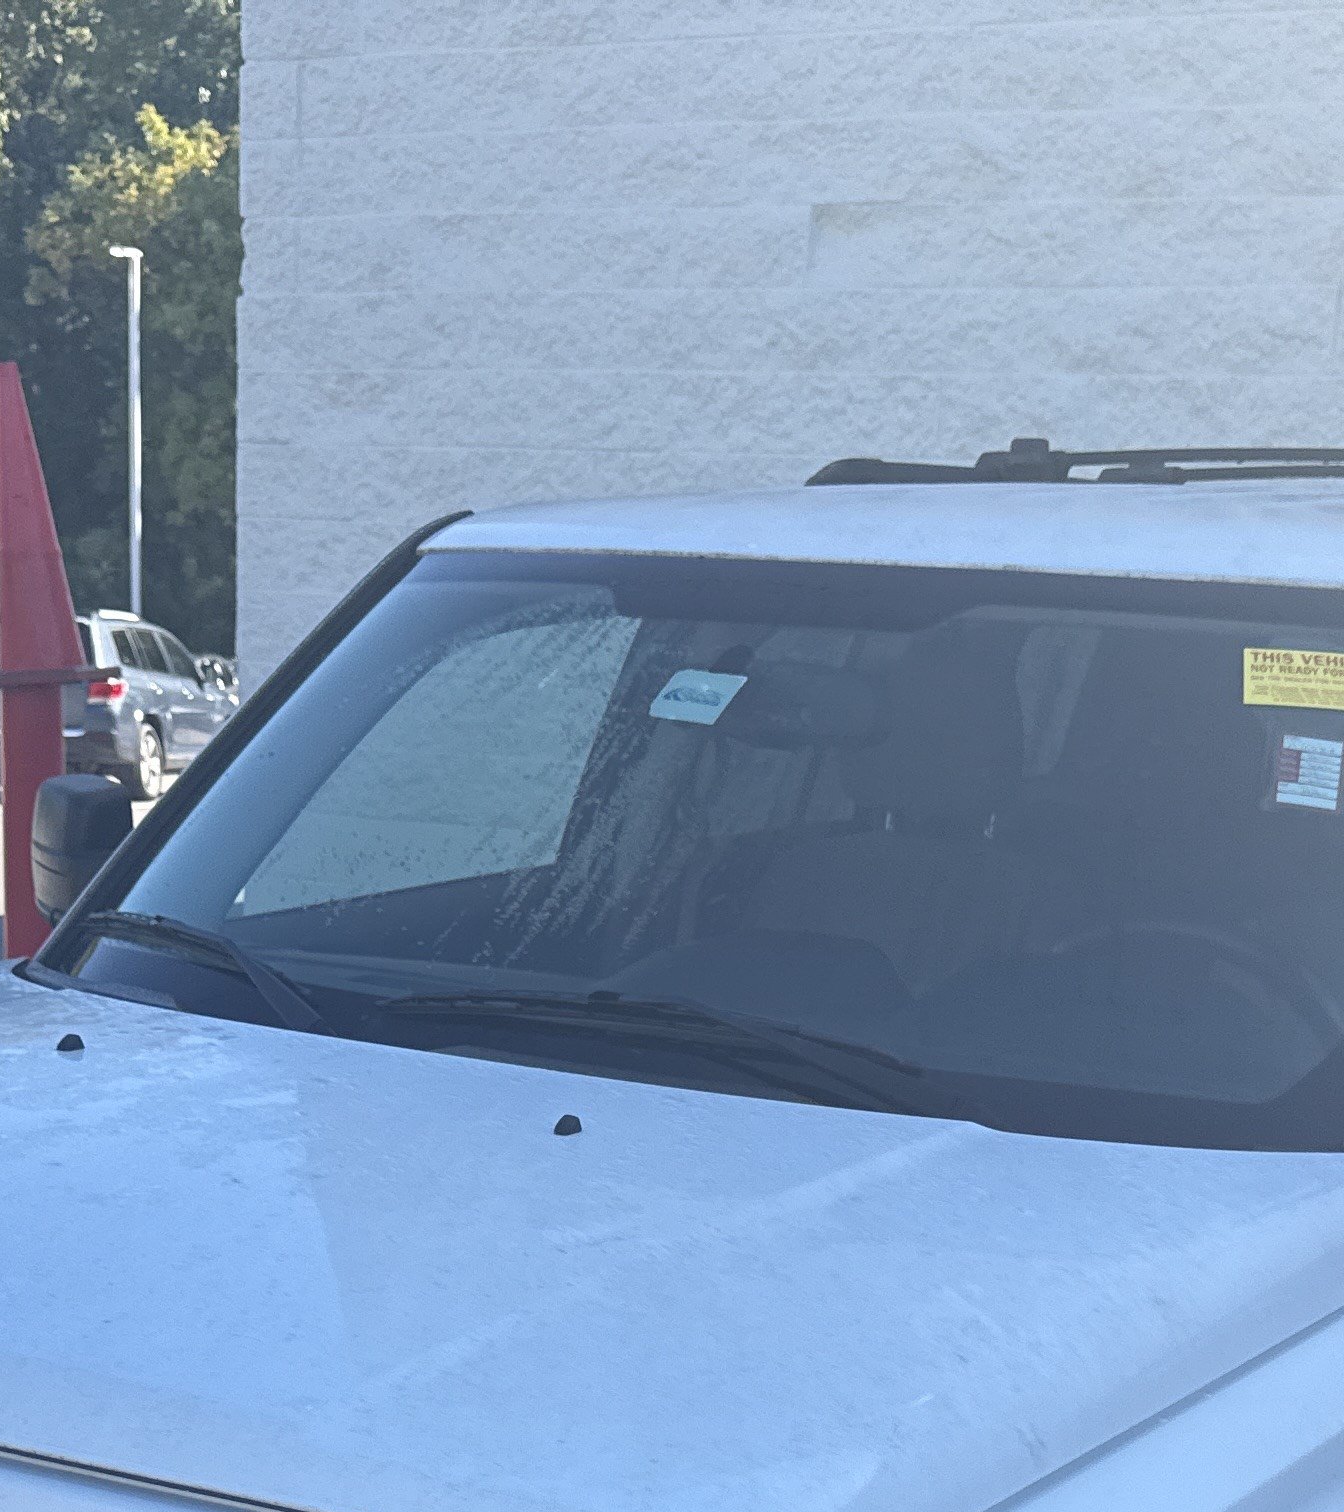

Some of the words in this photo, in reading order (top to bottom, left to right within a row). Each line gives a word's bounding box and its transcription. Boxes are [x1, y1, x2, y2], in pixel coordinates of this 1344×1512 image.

[1251, 652, 1294, 664] THIS
[1250, 664, 1275, 673] NOT
[1279, 665, 1319, 675] READY
